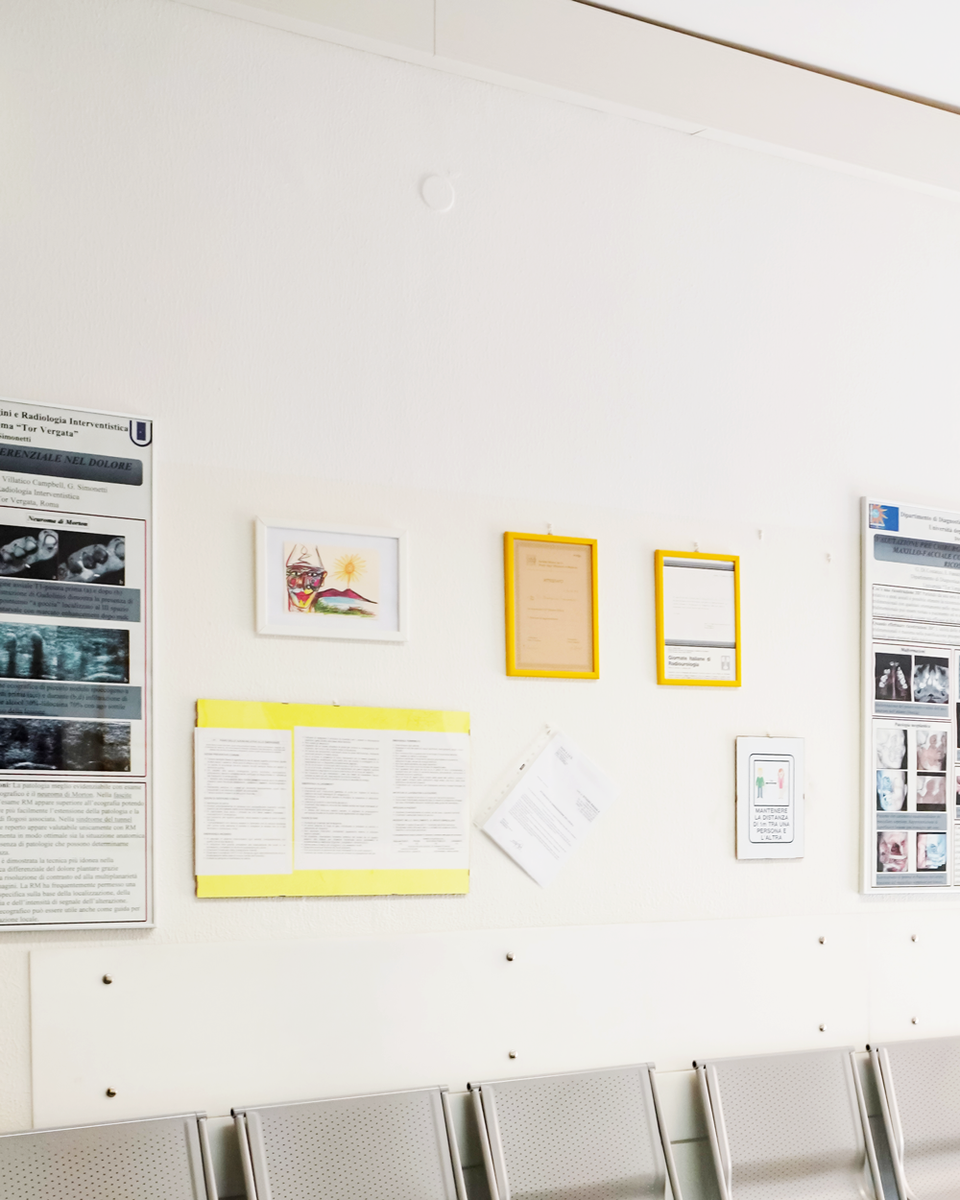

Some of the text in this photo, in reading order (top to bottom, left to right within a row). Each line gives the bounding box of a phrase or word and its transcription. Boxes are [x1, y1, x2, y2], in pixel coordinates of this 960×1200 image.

[21, 411, 67, 424] Radiologia
[69, 417, 129, 432] Interventistica
[16, 422, 38, 433] "Tor
[40, 425, 79, 437] Vergata"
[64, 455, 86, 466] NEL
[88, 457, 133, 471] DOLORE
[1, 475, 31, 486] Villatico
[32, 478, 66, 490] Campbell,
[77, 484, 108, 493] Simonetti
[33, 489, 80, 500] Interventistica
[10, 497, 60, 508] Vergata, Roma
[28, 514, 57, 524] Neuroma
[66, 518, 89, 527] Morton
[59, 898, 81, 906] segnale
[114, 905, 130, 913] guida
